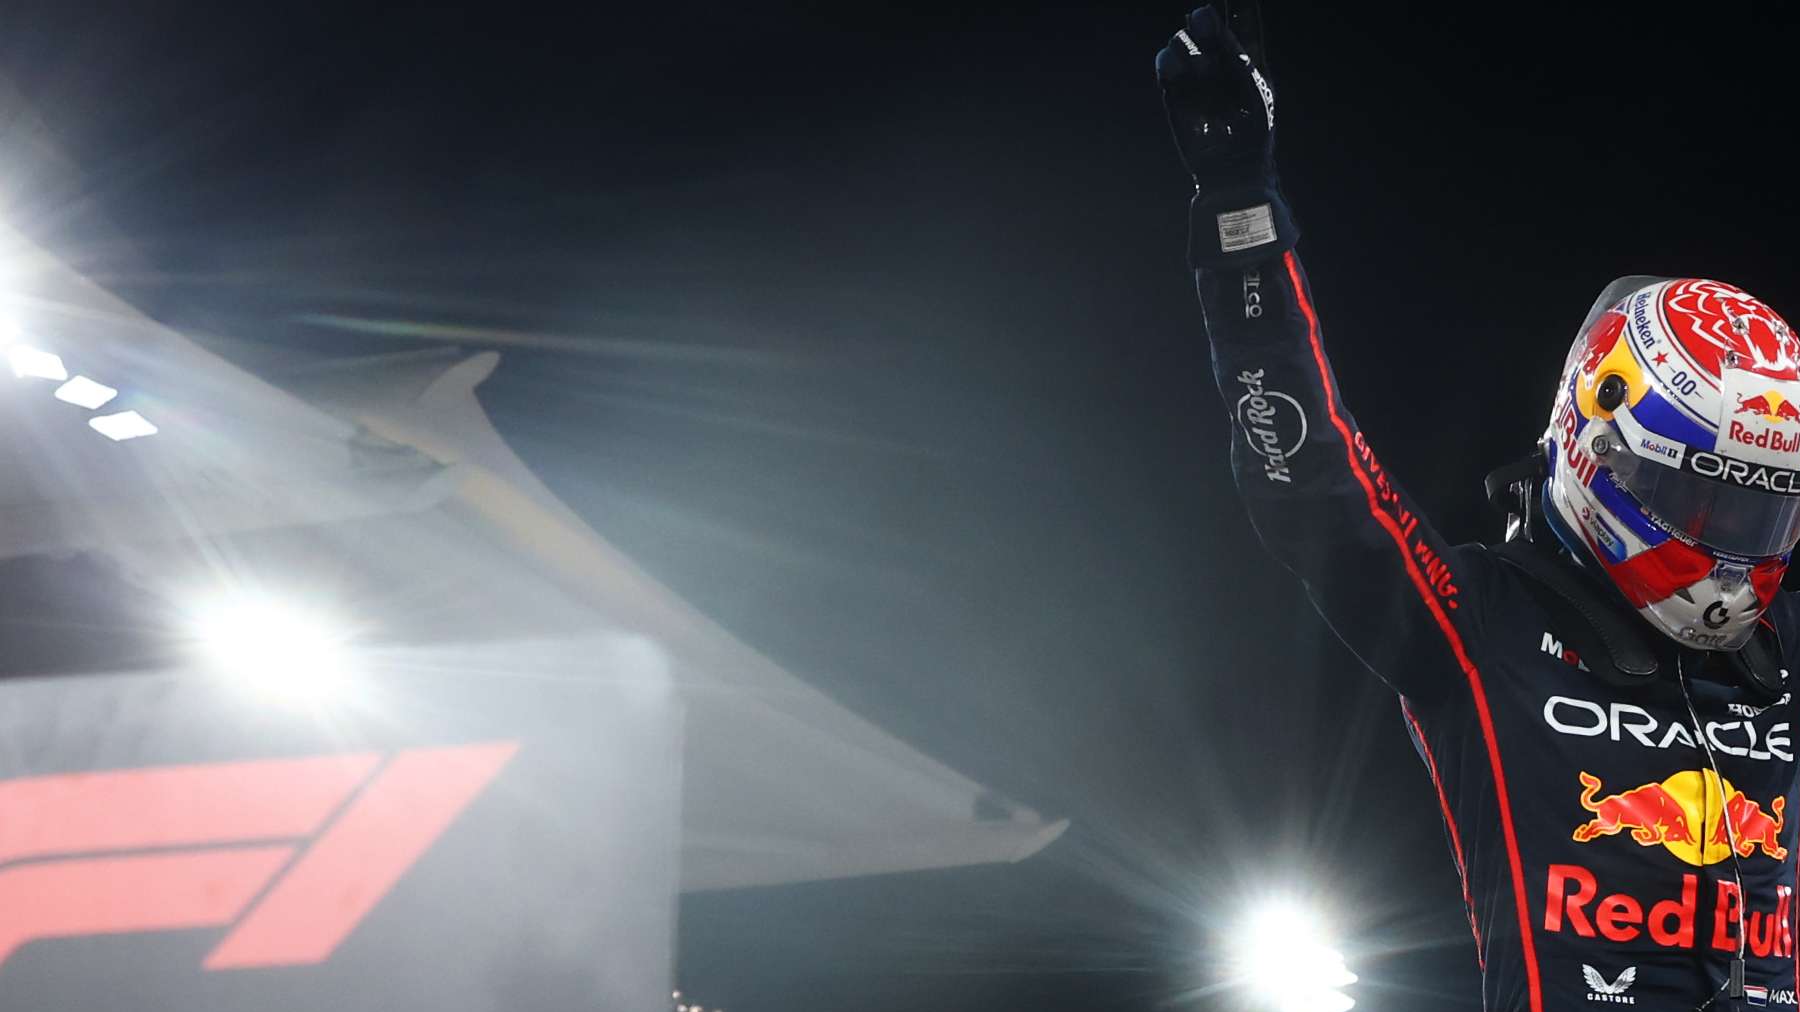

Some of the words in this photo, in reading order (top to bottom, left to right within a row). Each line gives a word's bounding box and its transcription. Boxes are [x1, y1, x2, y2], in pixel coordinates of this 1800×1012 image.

[1634, 292, 1656, 350] Heineken
[1237, 368, 1276, 424] Rock
[1671, 371, 1697, 396] 0.0
[1252, 427, 1291, 483] Hard
[1640, 438, 1668, 455] Mobil
[1729, 420, 1769, 448] Red
[1543, 695, 1794, 762] ORACLE
[1544, 864, 1698, 948] Red
[1712, 879, 1793, 958] Bull
[1587, 993, 1635, 1004] CASTORE
[1769, 989, 1798, 1005] MAX
